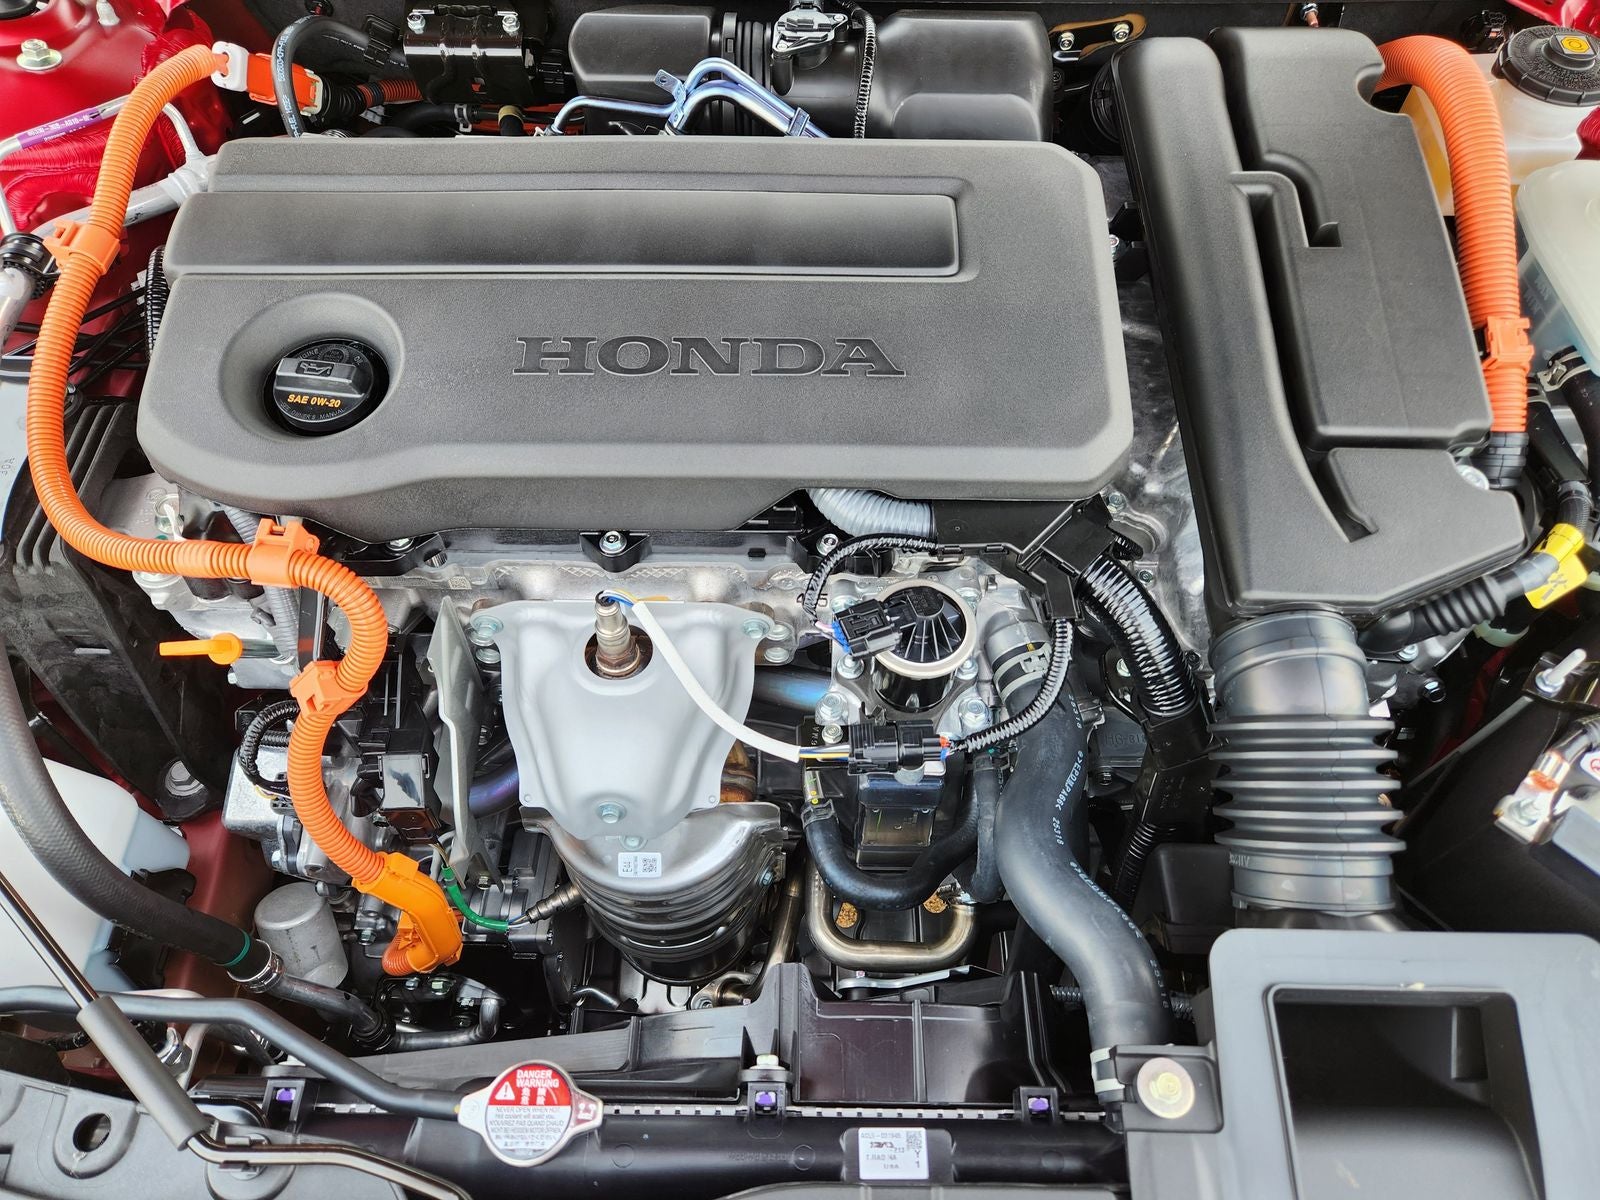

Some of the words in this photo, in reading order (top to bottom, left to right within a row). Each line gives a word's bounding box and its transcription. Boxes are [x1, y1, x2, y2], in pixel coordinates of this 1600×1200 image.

[513, 335, 907, 377] HONDA
[287, 393, 309, 404] SAE
[310, 396, 341, 408] 0W-20
[516, 1069, 553, 1079] DANGER
[516, 1078, 560, 1089] WARNUNG
